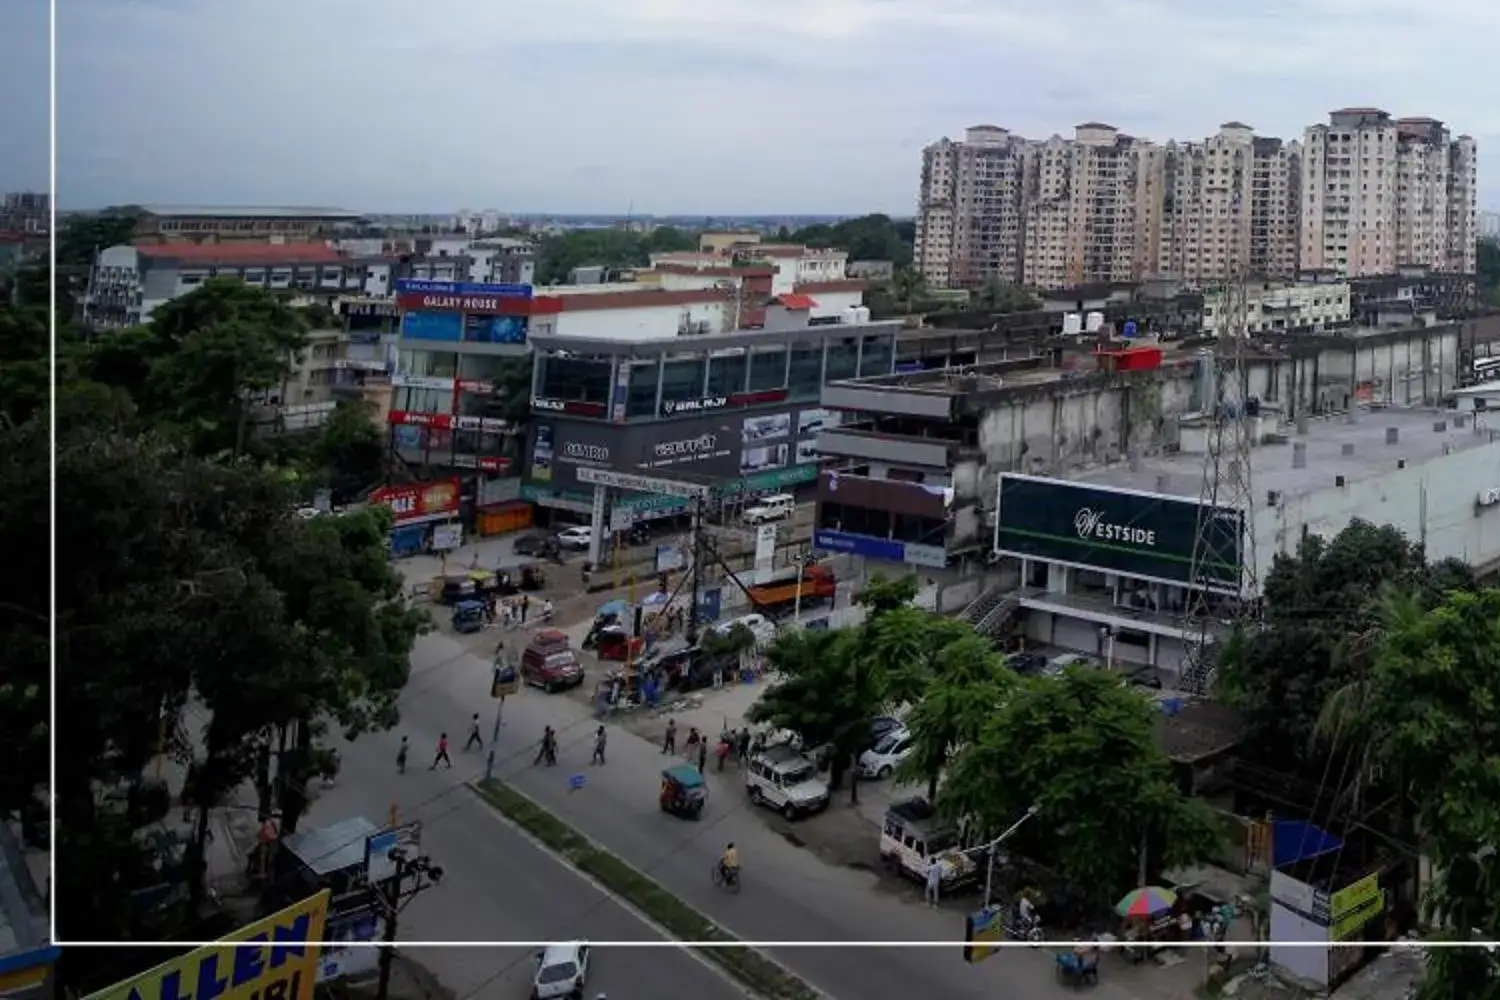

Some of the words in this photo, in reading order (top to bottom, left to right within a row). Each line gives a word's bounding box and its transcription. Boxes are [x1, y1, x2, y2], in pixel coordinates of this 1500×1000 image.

[423, 295, 461, 308] GALAXY
[463, 297, 497, 310] HOUSE
[1073, 506, 1156, 546] WESTSIDE
